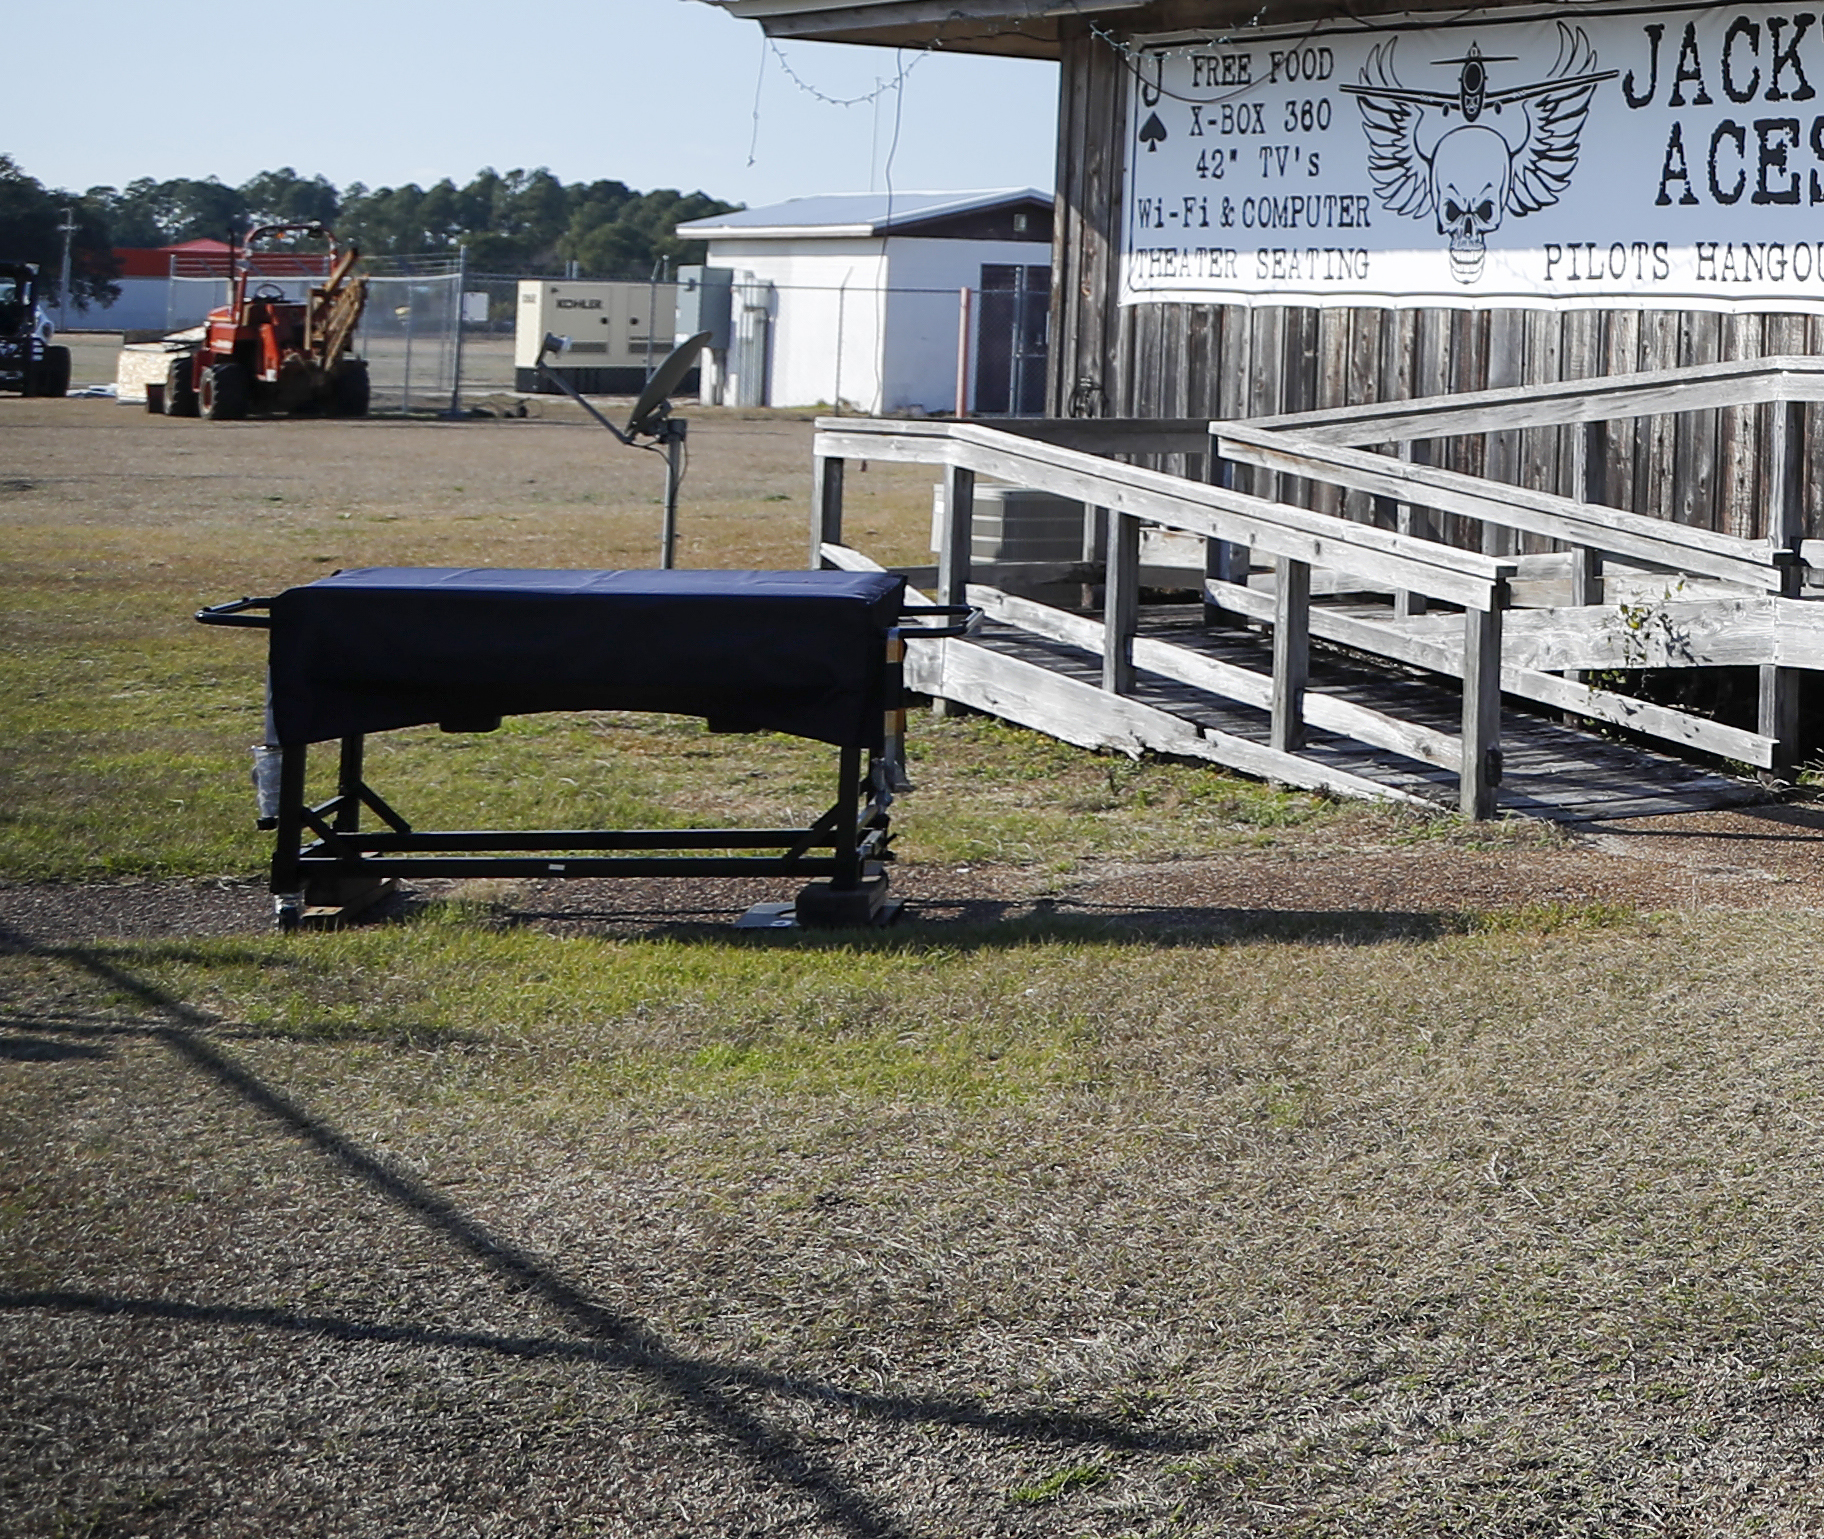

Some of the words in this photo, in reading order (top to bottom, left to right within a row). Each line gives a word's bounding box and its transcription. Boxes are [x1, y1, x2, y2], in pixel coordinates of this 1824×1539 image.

[1191, 52, 1253, 87] FREE
[1268, 47, 1335, 84] FOOD
[1188, 102, 1267, 137] X-BOX
[1283, 97, 1332, 132] 360
[1195, 147, 1239, 180] 42"
[1258, 145, 1321, 178] TV's
[1137, 196, 1210, 229] Wi-Fi
[1219, 196, 1236, 229] &
[1241, 195, 1372, 229] COMPUTER
[1134, 246, 1239, 280] THEATER
[1255, 246, 1371, 281] SEATING
[1543, 240, 1670, 282] PILOTS
[557, 299, 603, 310] KOHLER
